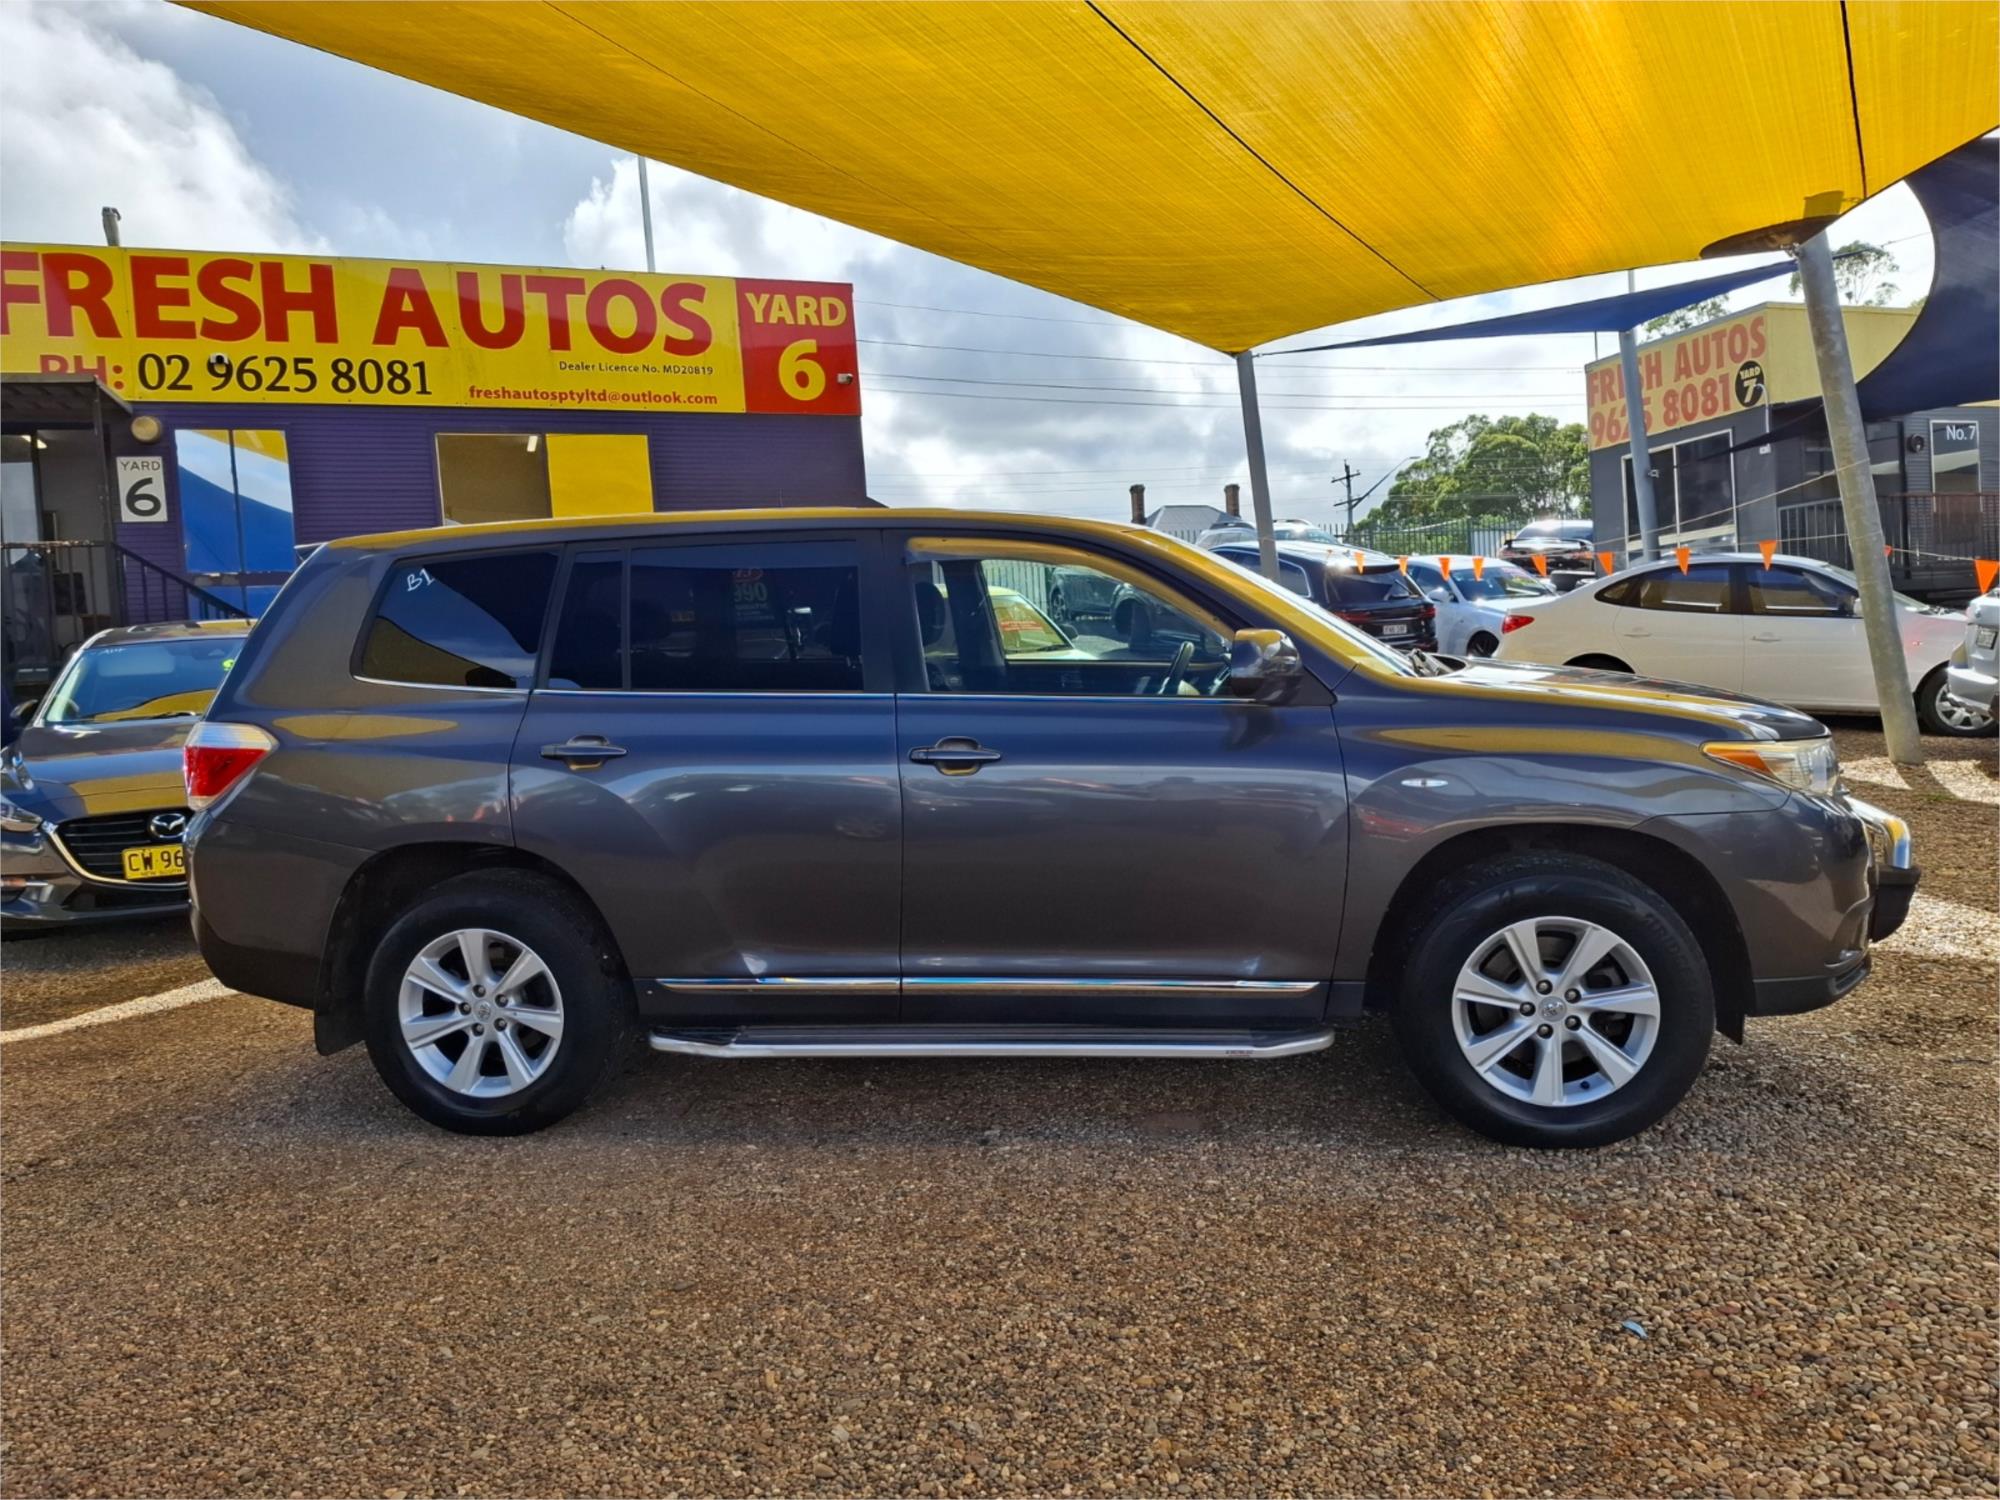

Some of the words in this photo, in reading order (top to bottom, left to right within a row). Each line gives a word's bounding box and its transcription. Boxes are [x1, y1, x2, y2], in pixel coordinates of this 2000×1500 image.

[0, 251, 338, 344] FRESH
[372, 267, 713, 356] AUTOS
[745, 291, 847, 327] YARD
[138, 353, 193, 391] 02
[207, 353, 317, 393] 9625
[331, 357, 432, 396] 8081
[559, 361, 596, 372] Dealer
[598, 362, 640, 373] Licence
[642, 364, 661, 374] No.
[663, 365, 714, 376] MD20819
[777, 339, 827, 401] 6
[1590, 350, 1662, 408] FRH
[1674, 316, 1767, 383] AUTOS
[1740, 366, 1761, 381] YARD
[469, 386, 718, 405] freshautosptyltd@outlook.com
[1663, 373, 1731, 428] 8081
[1743, 378, 1758, 404] 7
[120, 460, 161, 472] YARD
[126, 477, 162, 517] 6
